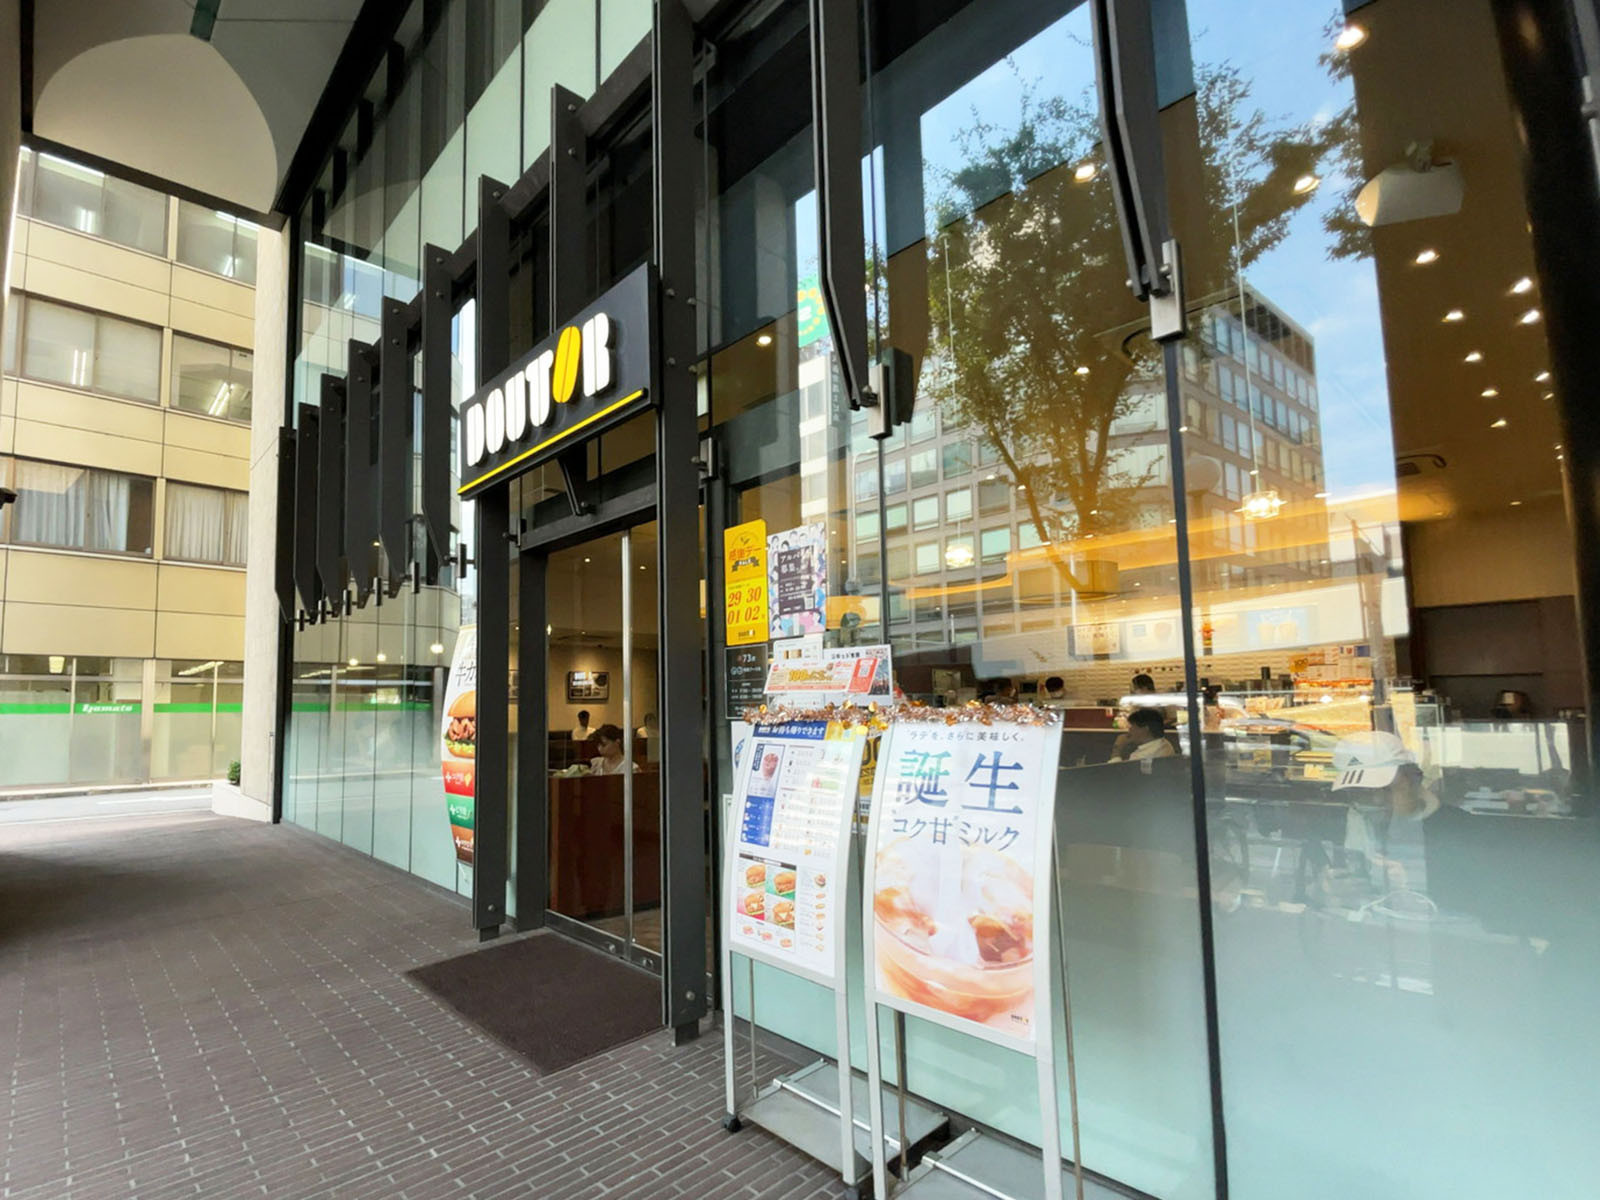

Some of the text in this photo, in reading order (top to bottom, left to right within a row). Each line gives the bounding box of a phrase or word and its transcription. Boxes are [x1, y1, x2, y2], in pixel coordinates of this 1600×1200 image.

[467, 313, 610, 468] DOUTOR
[727, 605, 761, 625] 01 02
[728, 591, 742, 607] 29
[746, 586, 762, 603] 30
[896, 749, 1024, 815] 誕生
